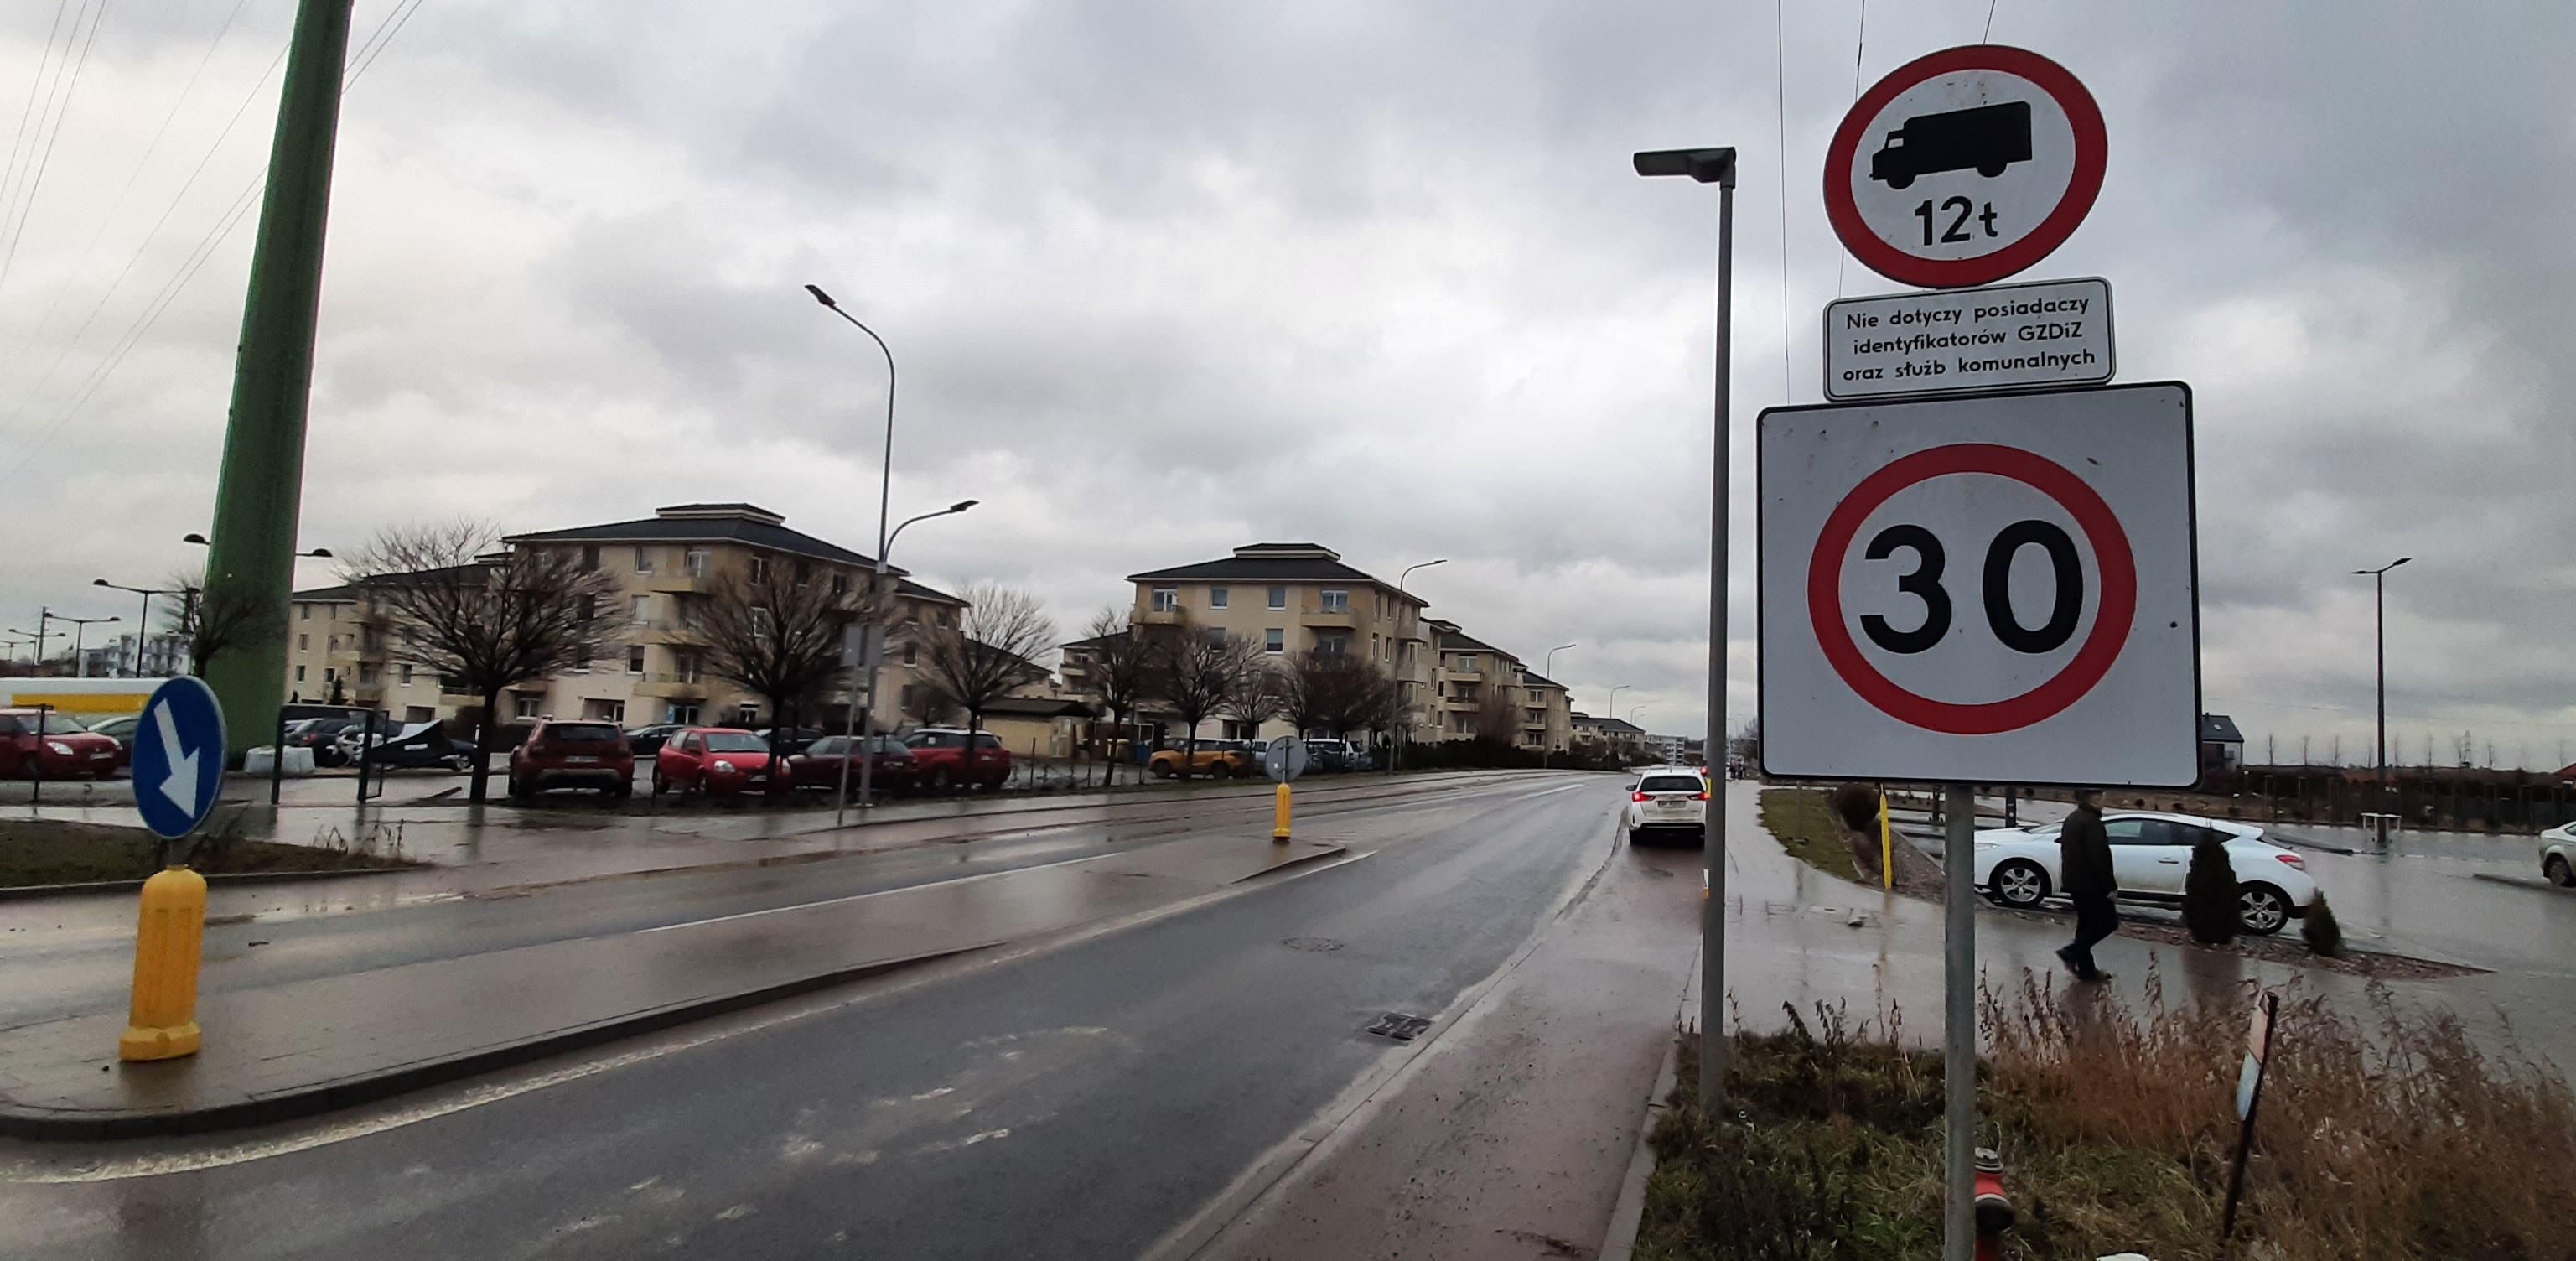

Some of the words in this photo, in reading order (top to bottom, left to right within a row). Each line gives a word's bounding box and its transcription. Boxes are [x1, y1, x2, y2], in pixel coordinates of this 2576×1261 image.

[1847, 313, 1879, 330] Nie
[1889, 308, 1962, 328] dotyczy
[1974, 297, 2090, 324] posiadaczy
[1853, 328, 2007, 356] identyfikatorów
[2017, 321, 2083, 342] GZDiZ
[1843, 366, 1884, 381] oraz
[1894, 356, 1946, 378] służb
[1958, 348, 2096, 373] komunalnych
[1859, 519, 2085, 655] 30
